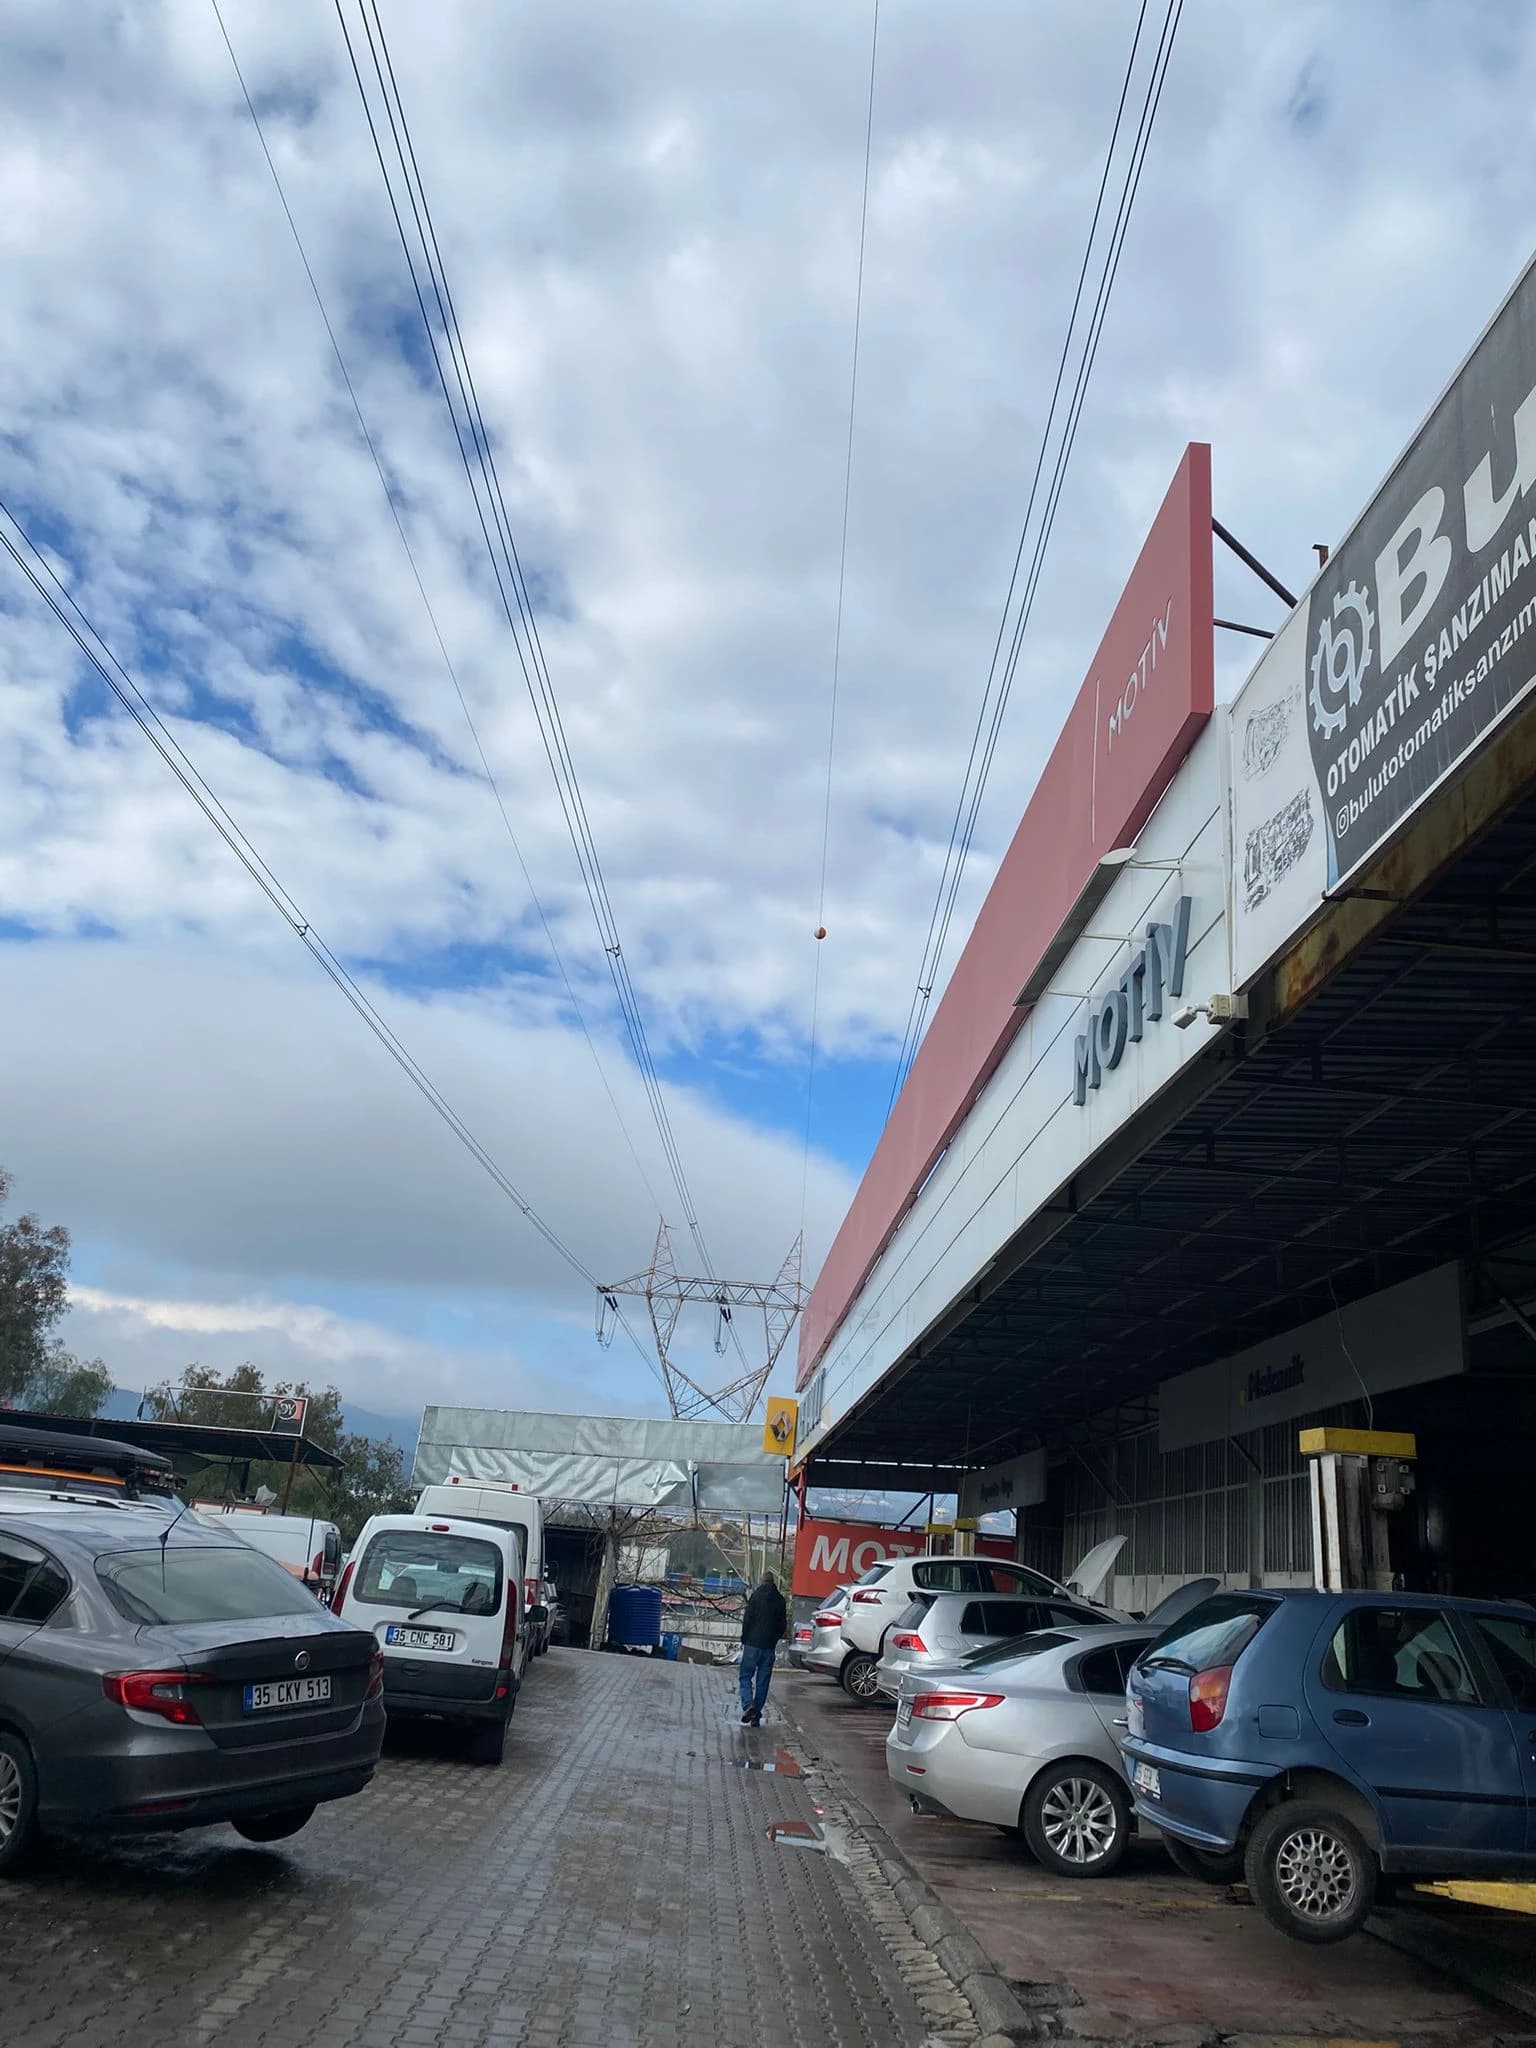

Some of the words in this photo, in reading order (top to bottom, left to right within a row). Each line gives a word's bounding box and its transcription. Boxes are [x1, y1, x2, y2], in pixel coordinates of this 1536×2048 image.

[1327, 661, 1420, 797] OTOMATİK
[393, 1629, 406, 1641] 35
[410, 1631, 429, 1644] CNC
[433, 1634, 452, 1647] 581
[254, 1687, 270, 1706] 35
[307, 1678, 329, 1698] 513
